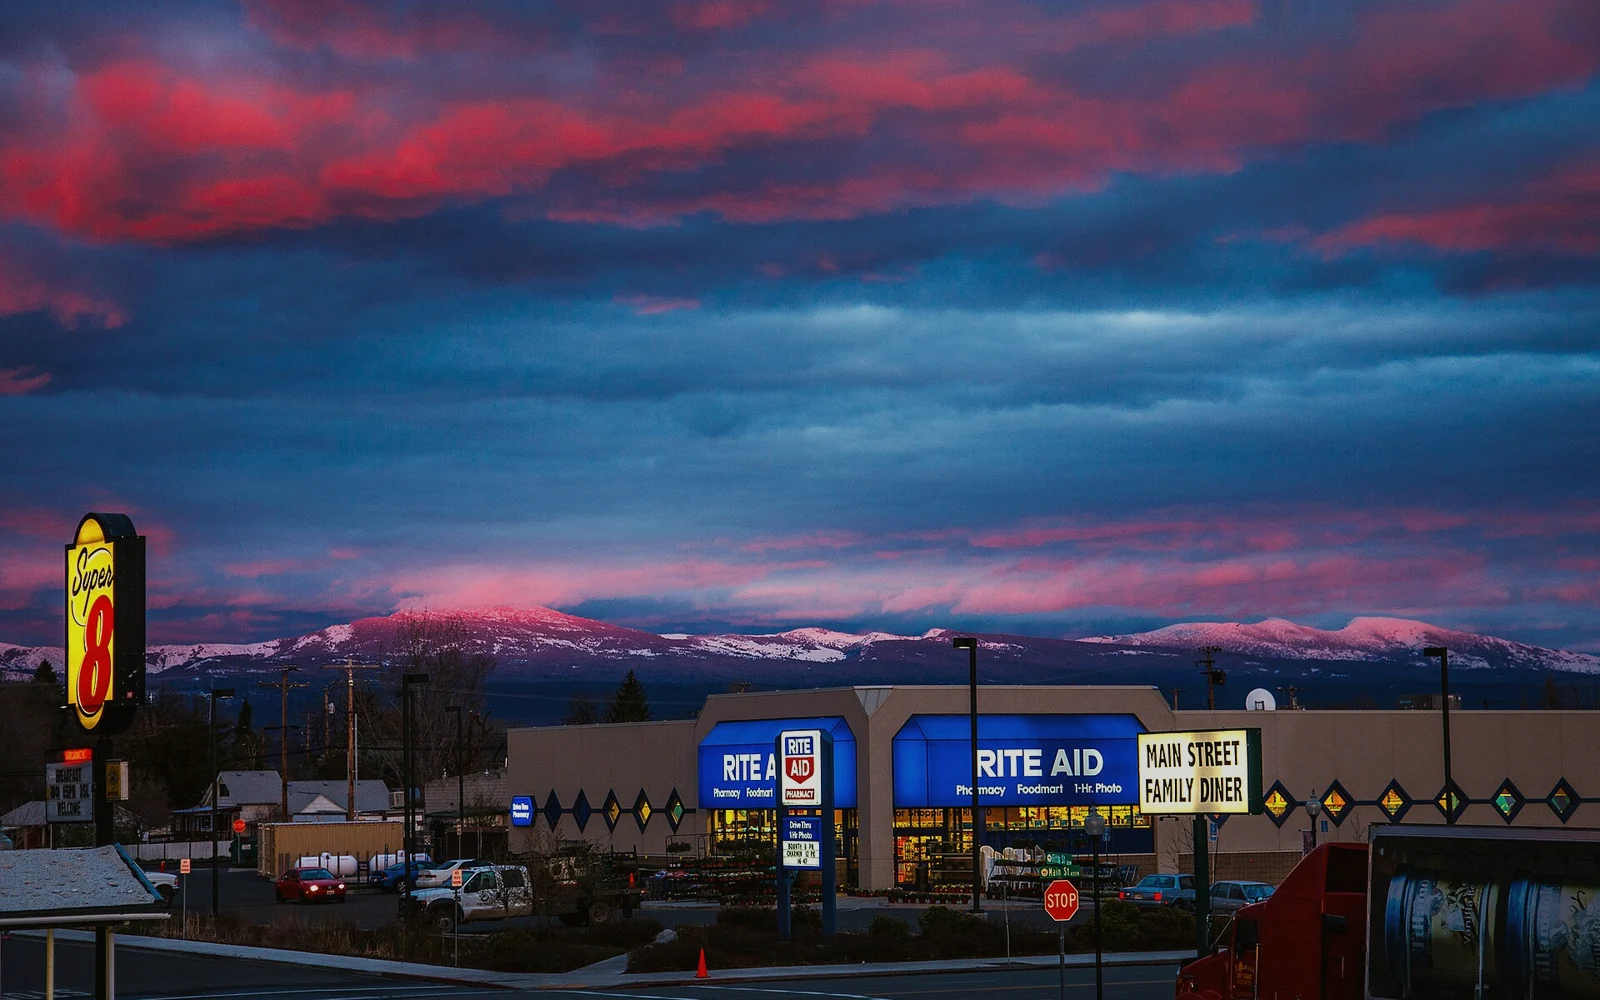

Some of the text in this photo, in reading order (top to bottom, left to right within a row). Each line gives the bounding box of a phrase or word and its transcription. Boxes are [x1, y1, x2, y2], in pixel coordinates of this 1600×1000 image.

[72, 546, 114, 617] Super
[77, 594, 114, 715] 8
[788, 738, 811, 755] RITE
[1146, 741, 1240, 768] MAIN STREET
[723, 753, 762, 781] RITE
[790, 759, 810, 776] AID
[977, 749, 1104, 778] RITE AID
[55, 767, 82, 783] BREAKFAST
[713, 787, 773, 799] Pharmacy Foodmart
[786, 790, 814, 798] PHARMACY
[1017, 783, 1063, 795] Foodmart
[1074, 783, 1094, 794] 1-Hr.
[1096, 783, 1122, 794] Photo
[1146, 777, 1243, 803] FAMILY DINER
[57, 801, 80, 817] WELCOME
[908, 808, 944, 818] Shoppin
[798, 831, 813, 840] Photo
[1049, 867, 1061, 877] Main
[1063, 866, 1070, 876] St
[1047, 893, 1077, 908] STOP
[1463, 900, 1474, 945] Vanilla
